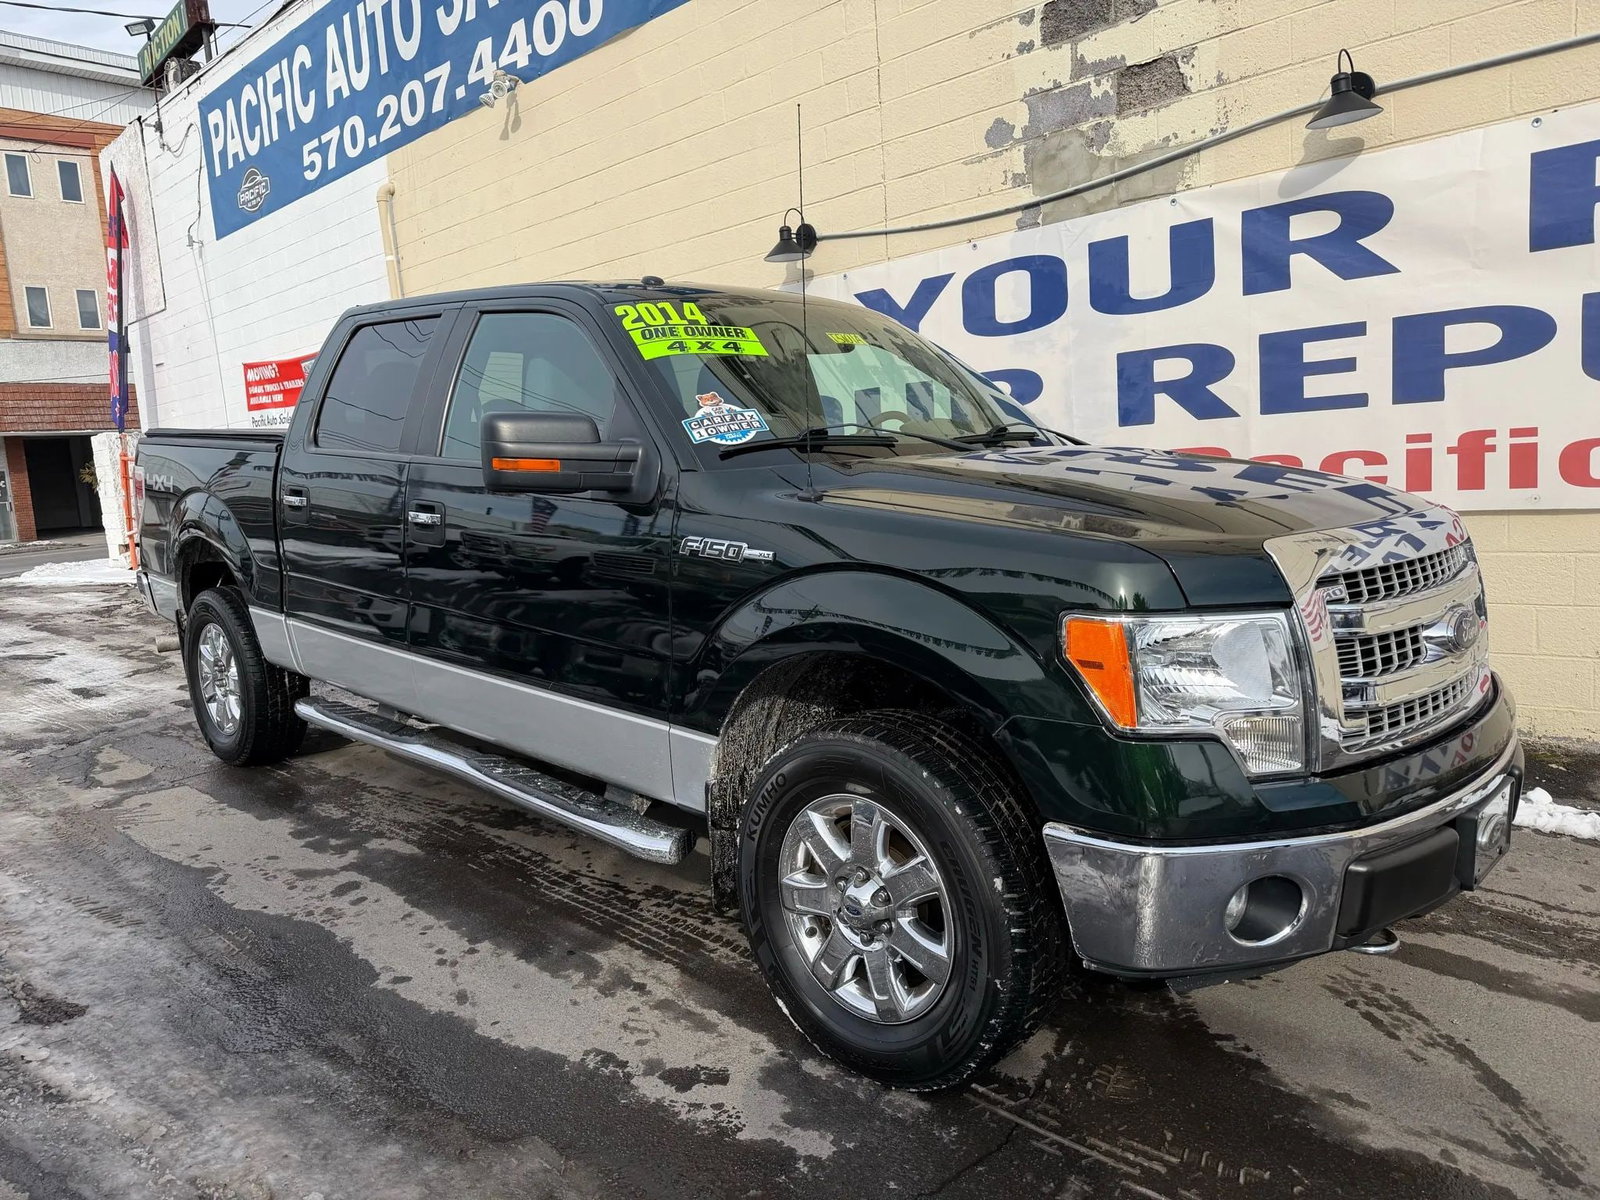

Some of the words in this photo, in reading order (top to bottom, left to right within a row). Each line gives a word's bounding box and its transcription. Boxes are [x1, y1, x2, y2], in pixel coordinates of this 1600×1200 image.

[143, 9, 181, 76] AUCTION
[207, 44, 316, 178] PACIFIC
[326, 0, 421, 110] AUTO
[302, 0, 603, 181] 570.207.4400
[240, 181, 266, 205] PACIFIC
[855, 189, 1401, 338] YOUR
[614, 301, 709, 331] 2014
[640, 326, 681, 341] ONE
[683, 326, 747, 339] OWNER
[246, 363, 280, 382] MOVING?
[690, 412, 757, 429] CARFAX
[707, 421, 762, 435] OWNER
[679, 536, 748, 563] F-150
[747, 772, 787, 842] KUMHO
